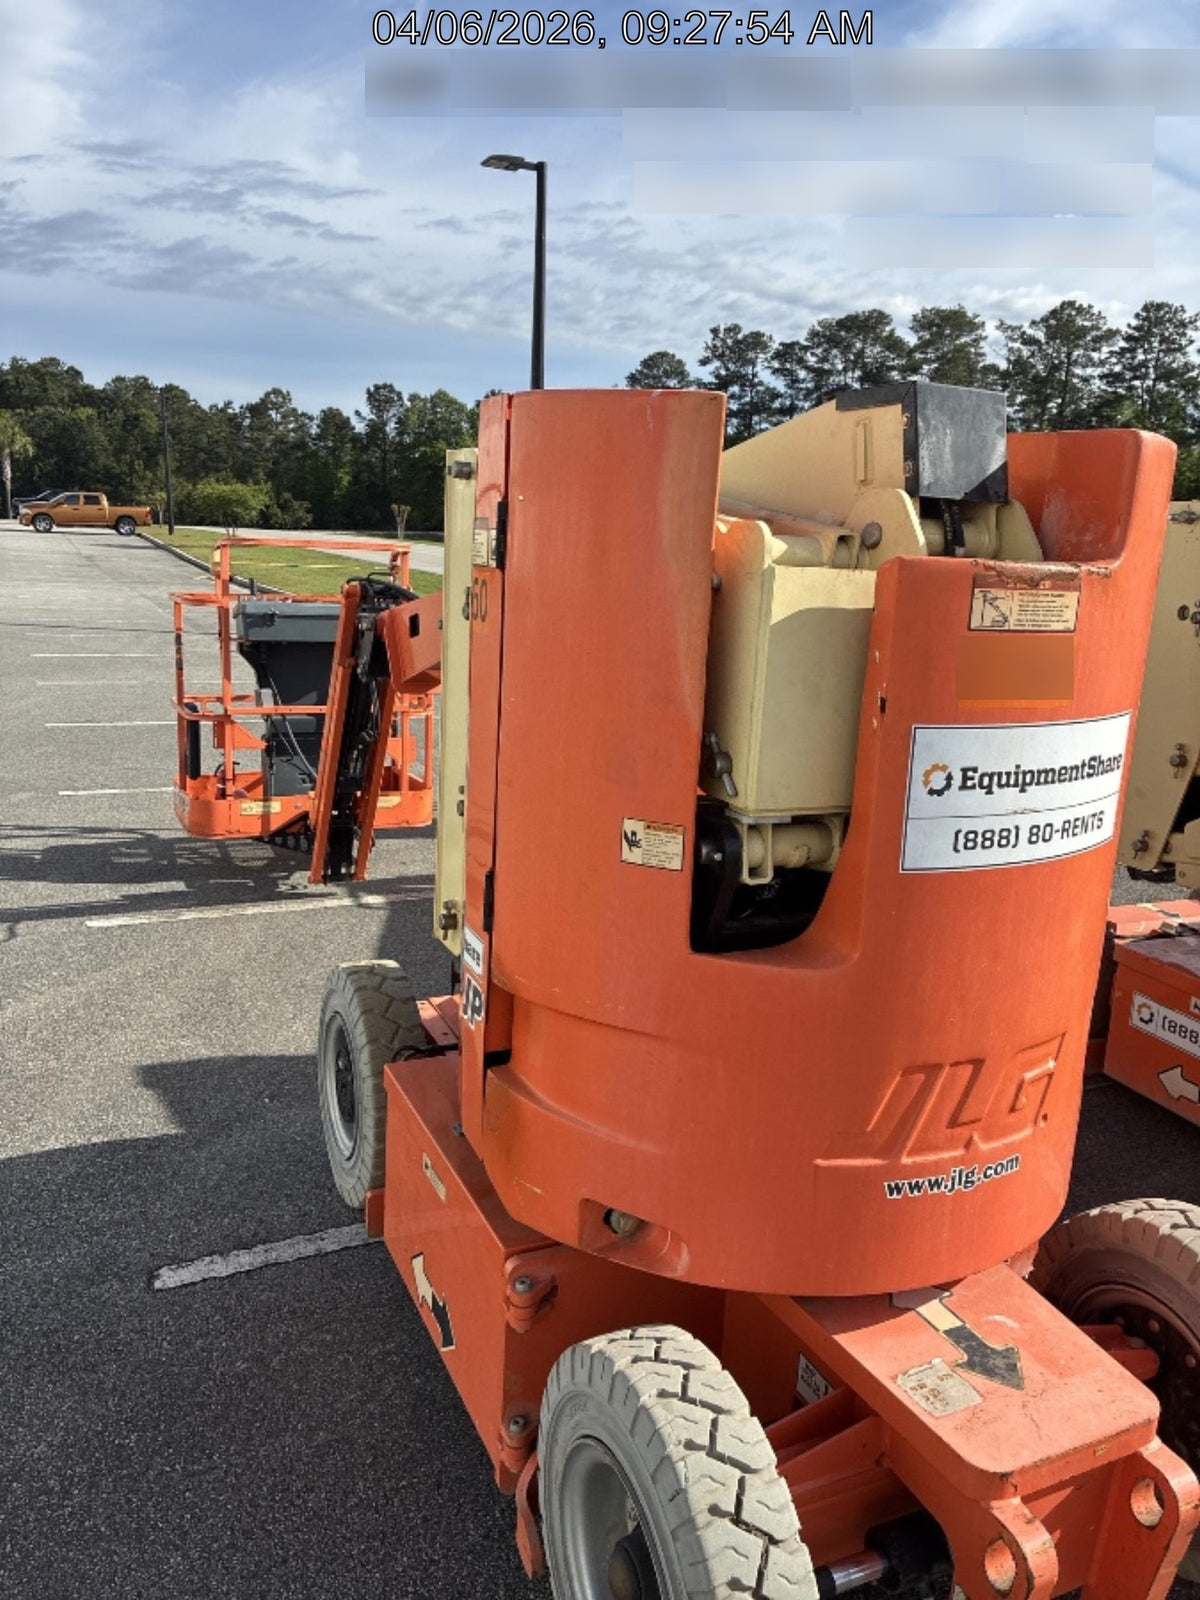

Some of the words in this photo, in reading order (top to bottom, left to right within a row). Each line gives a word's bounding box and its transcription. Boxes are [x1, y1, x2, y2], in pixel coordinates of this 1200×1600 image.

[958, 754, 1122, 795] EquipmentShare
[953, 825, 1020, 854] (888)
[1027, 811, 1105, 844] 80-RENTS
[1161, 1014, 1200, 1049] (888
[812, 1031, 1067, 1166] JLG
[884, 1154, 1020, 1198] www.jlg.com
